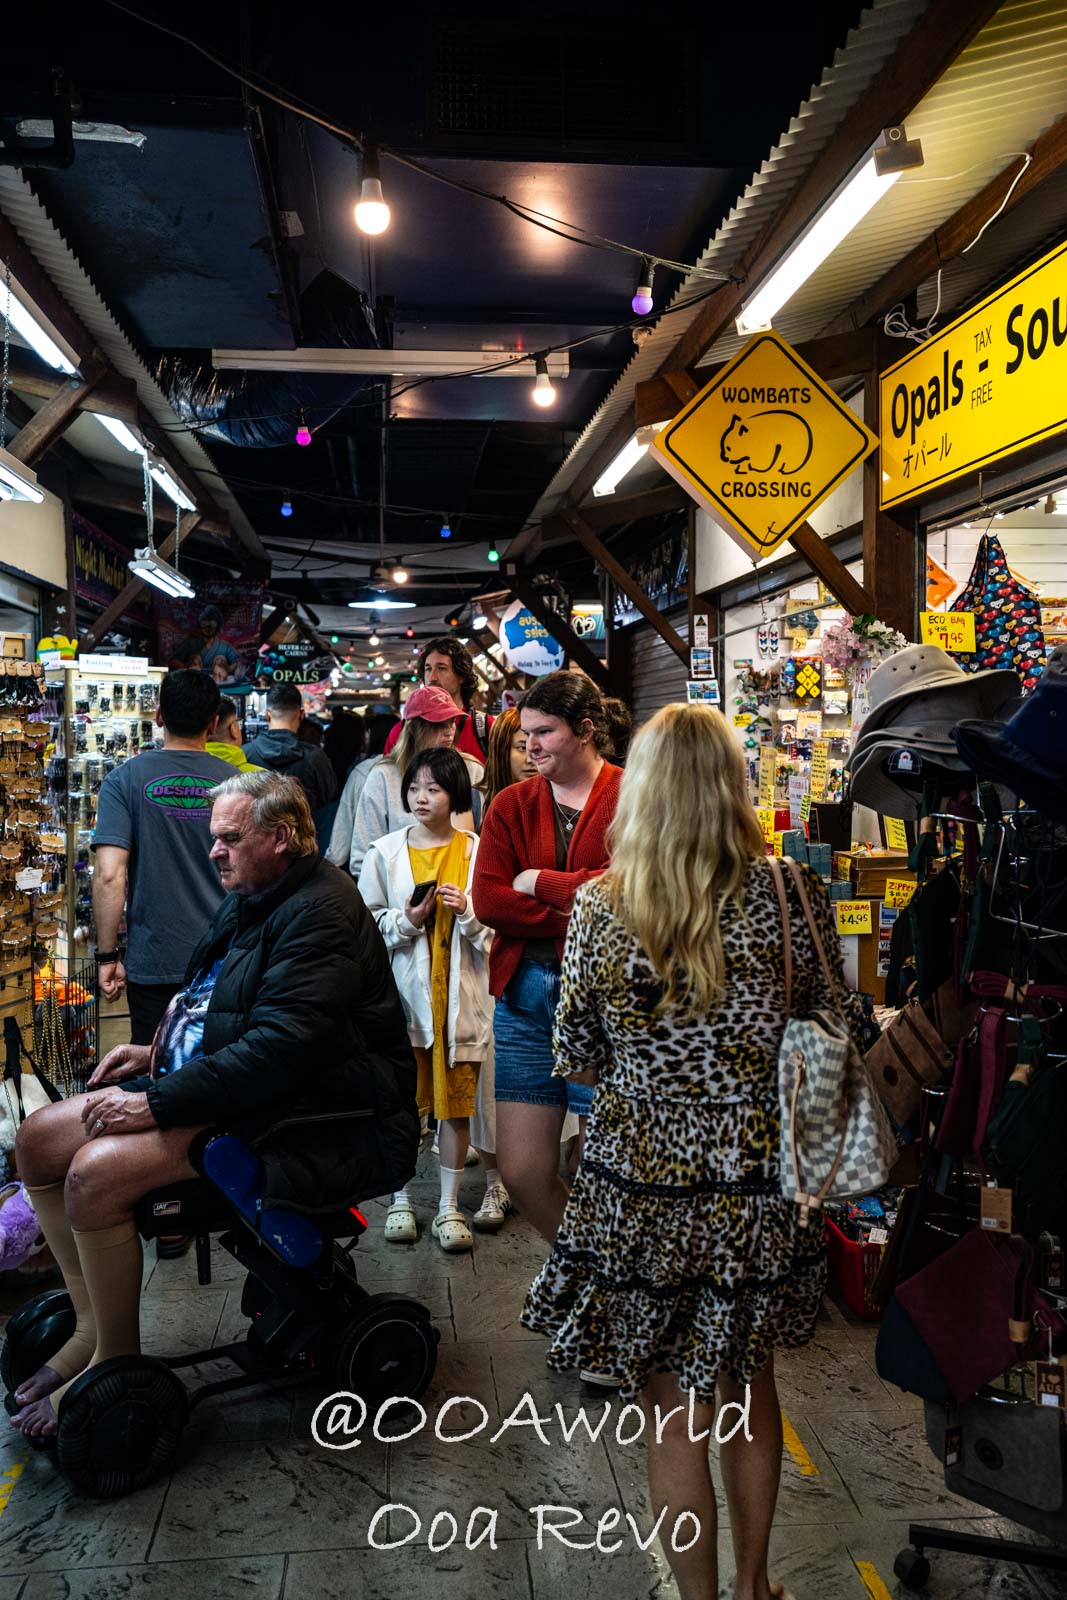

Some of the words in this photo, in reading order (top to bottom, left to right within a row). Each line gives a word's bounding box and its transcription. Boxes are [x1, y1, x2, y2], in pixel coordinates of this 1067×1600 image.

[974, 324, 993, 354] TAX
[722, 387, 812, 404] WOMBATS
[891, 349, 964, 445] Opals
[971, 380, 993, 410] FREE
[903, 432, 953, 479] オパール
[721, 482, 812, 498] CROSSING
[928, 615, 946, 625] ECO
[950, 615, 966, 628] BAG
[273, 669, 320, 683] OPALS
[839, 913, 869, 925] $4.95
